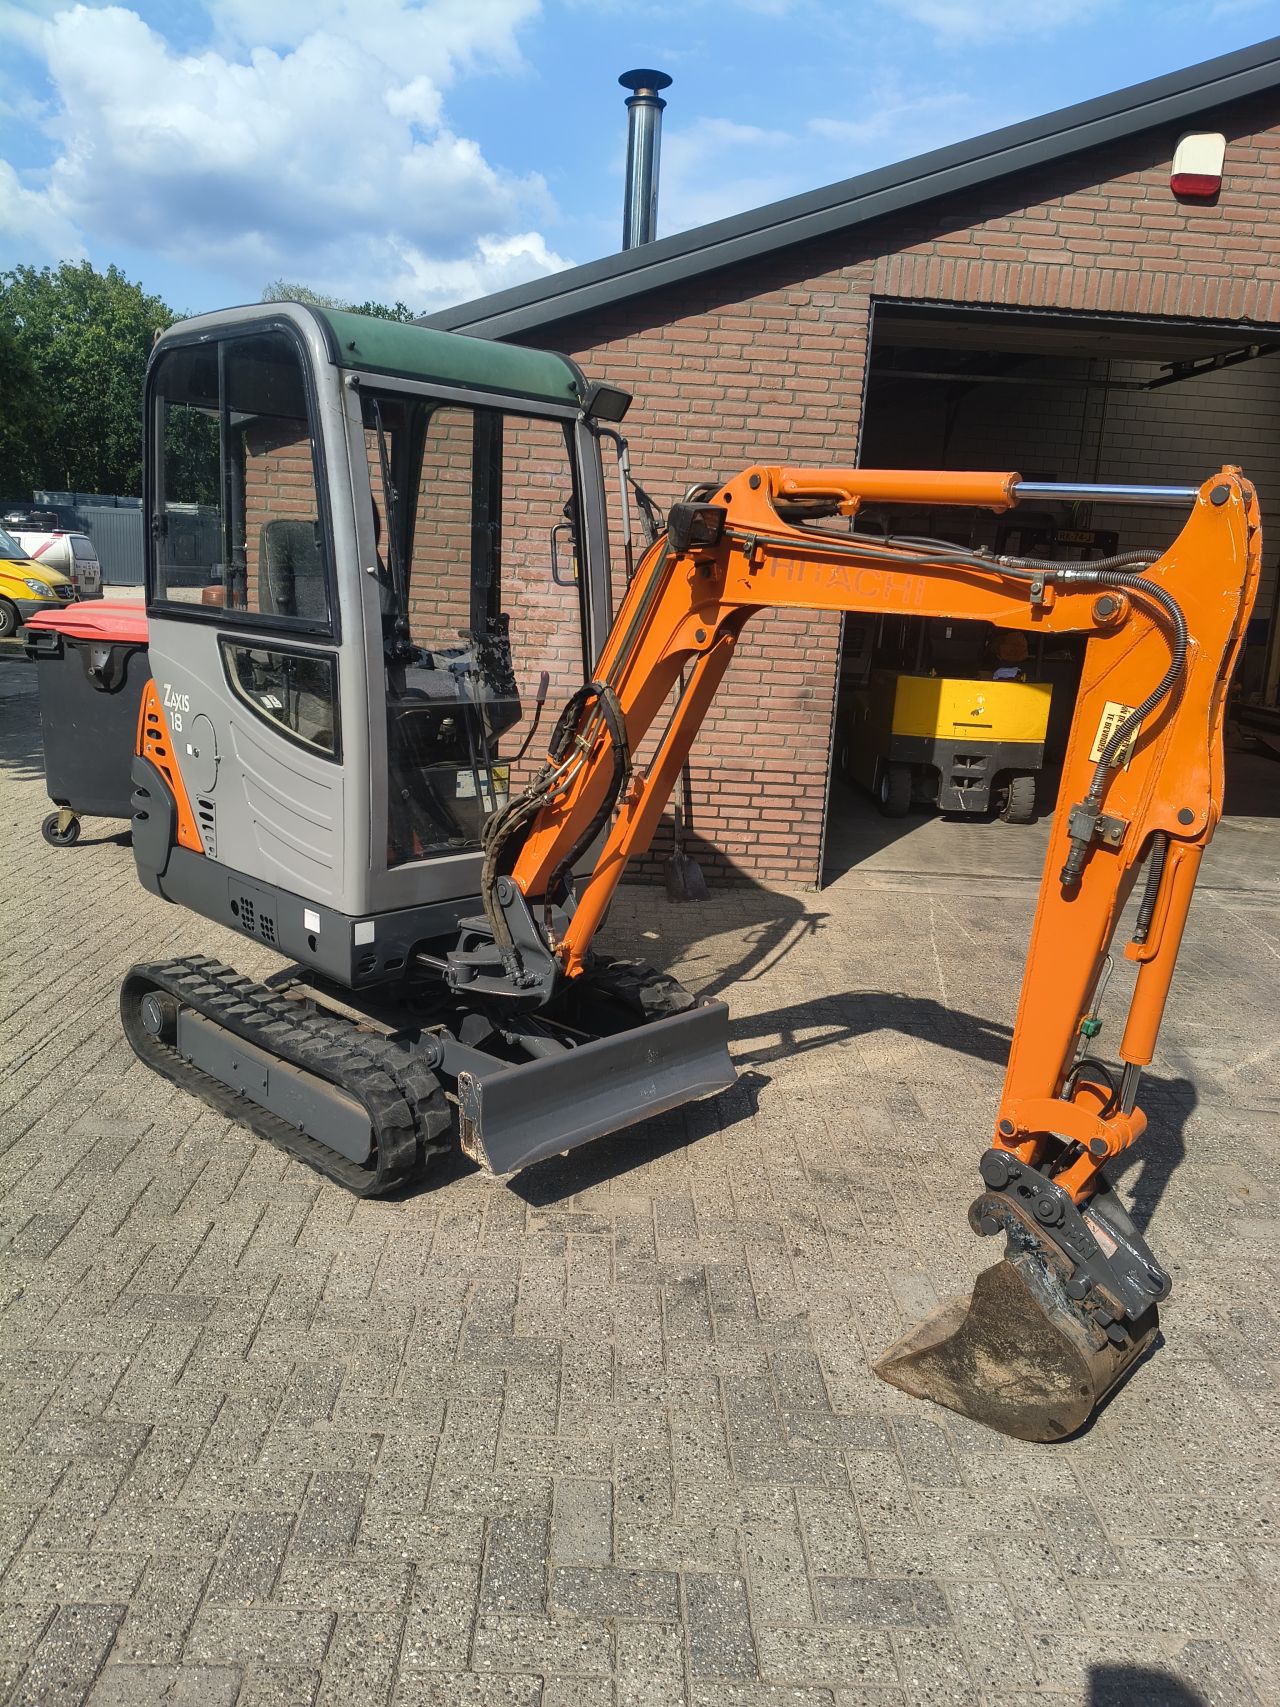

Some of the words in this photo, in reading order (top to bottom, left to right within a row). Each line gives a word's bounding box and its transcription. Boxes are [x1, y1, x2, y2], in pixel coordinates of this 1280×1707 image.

[770, 557, 926, 606] HITACHI
[163, 683, 190, 712] ZAXIS
[170, 711, 183, 732] 18
